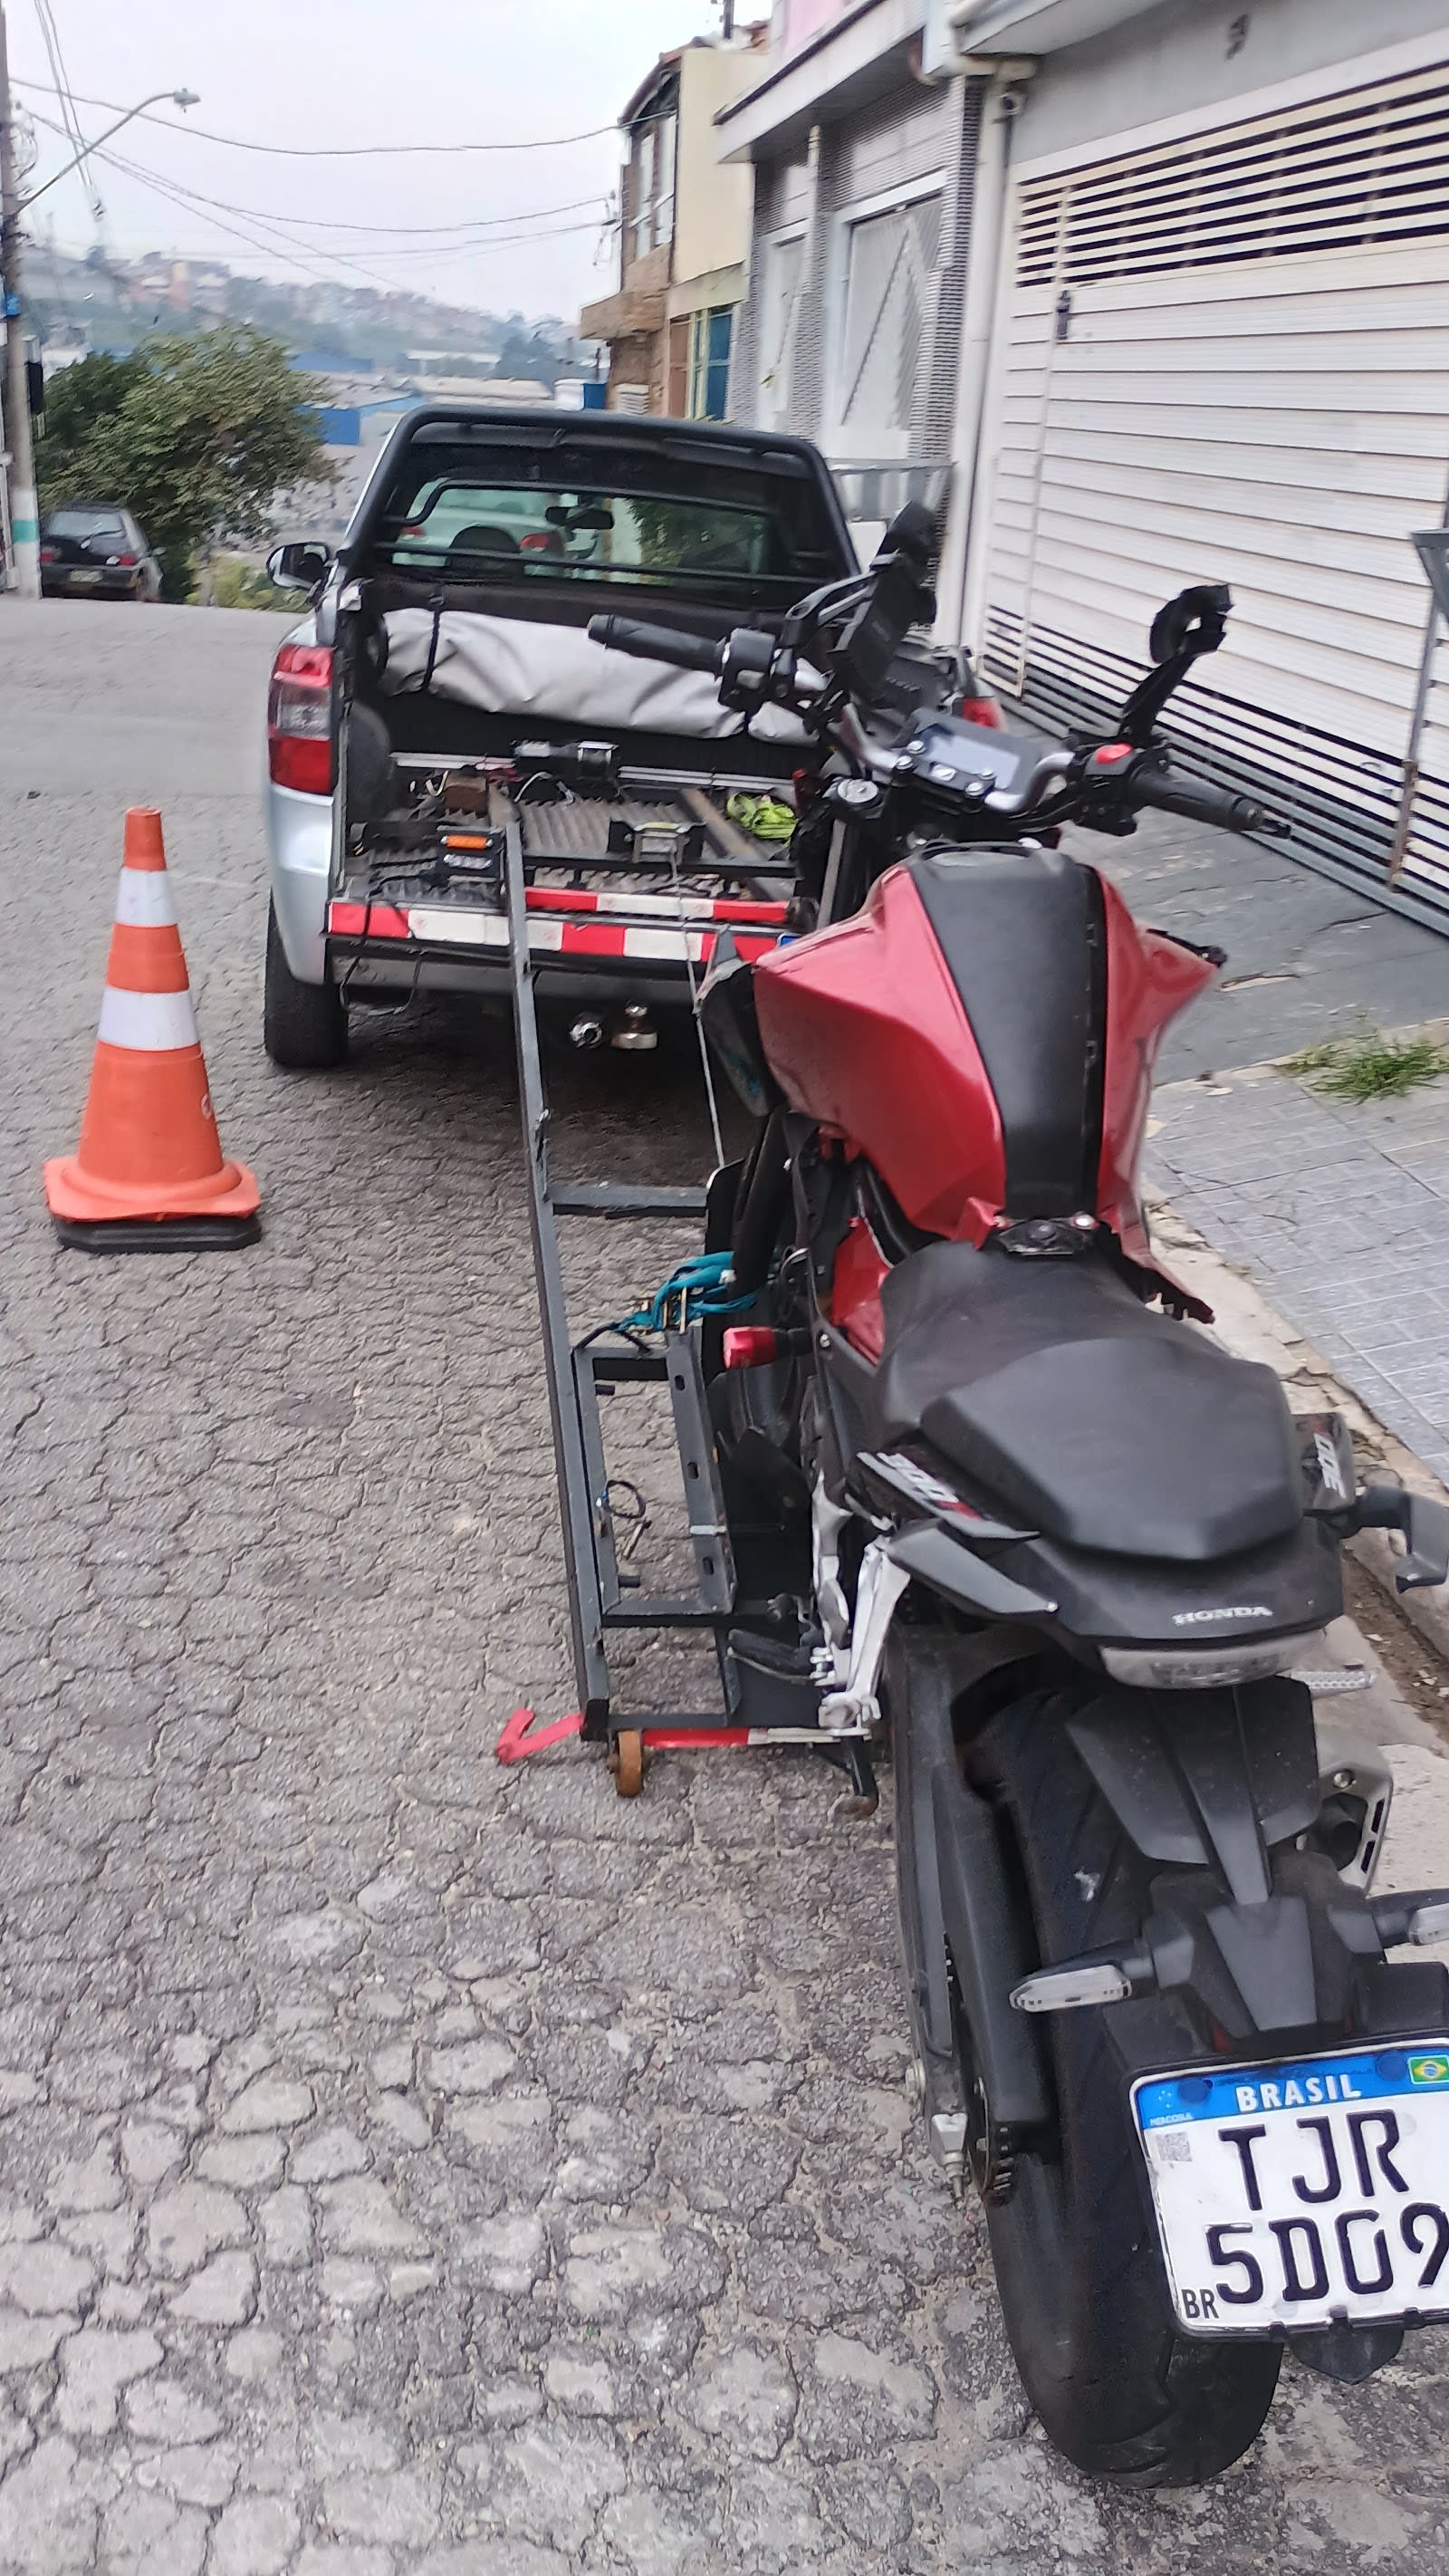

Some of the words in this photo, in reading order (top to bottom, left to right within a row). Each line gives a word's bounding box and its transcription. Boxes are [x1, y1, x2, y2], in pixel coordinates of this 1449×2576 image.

[1171, 1606, 1274, 1627] HONDA
[1235, 2072, 1362, 2113] BRASIL
[1217, 2109, 1410, 2212] TJR
[1204, 2202, 1449, 2305] 5D09
[1182, 2287, 1220, 2321] BR
